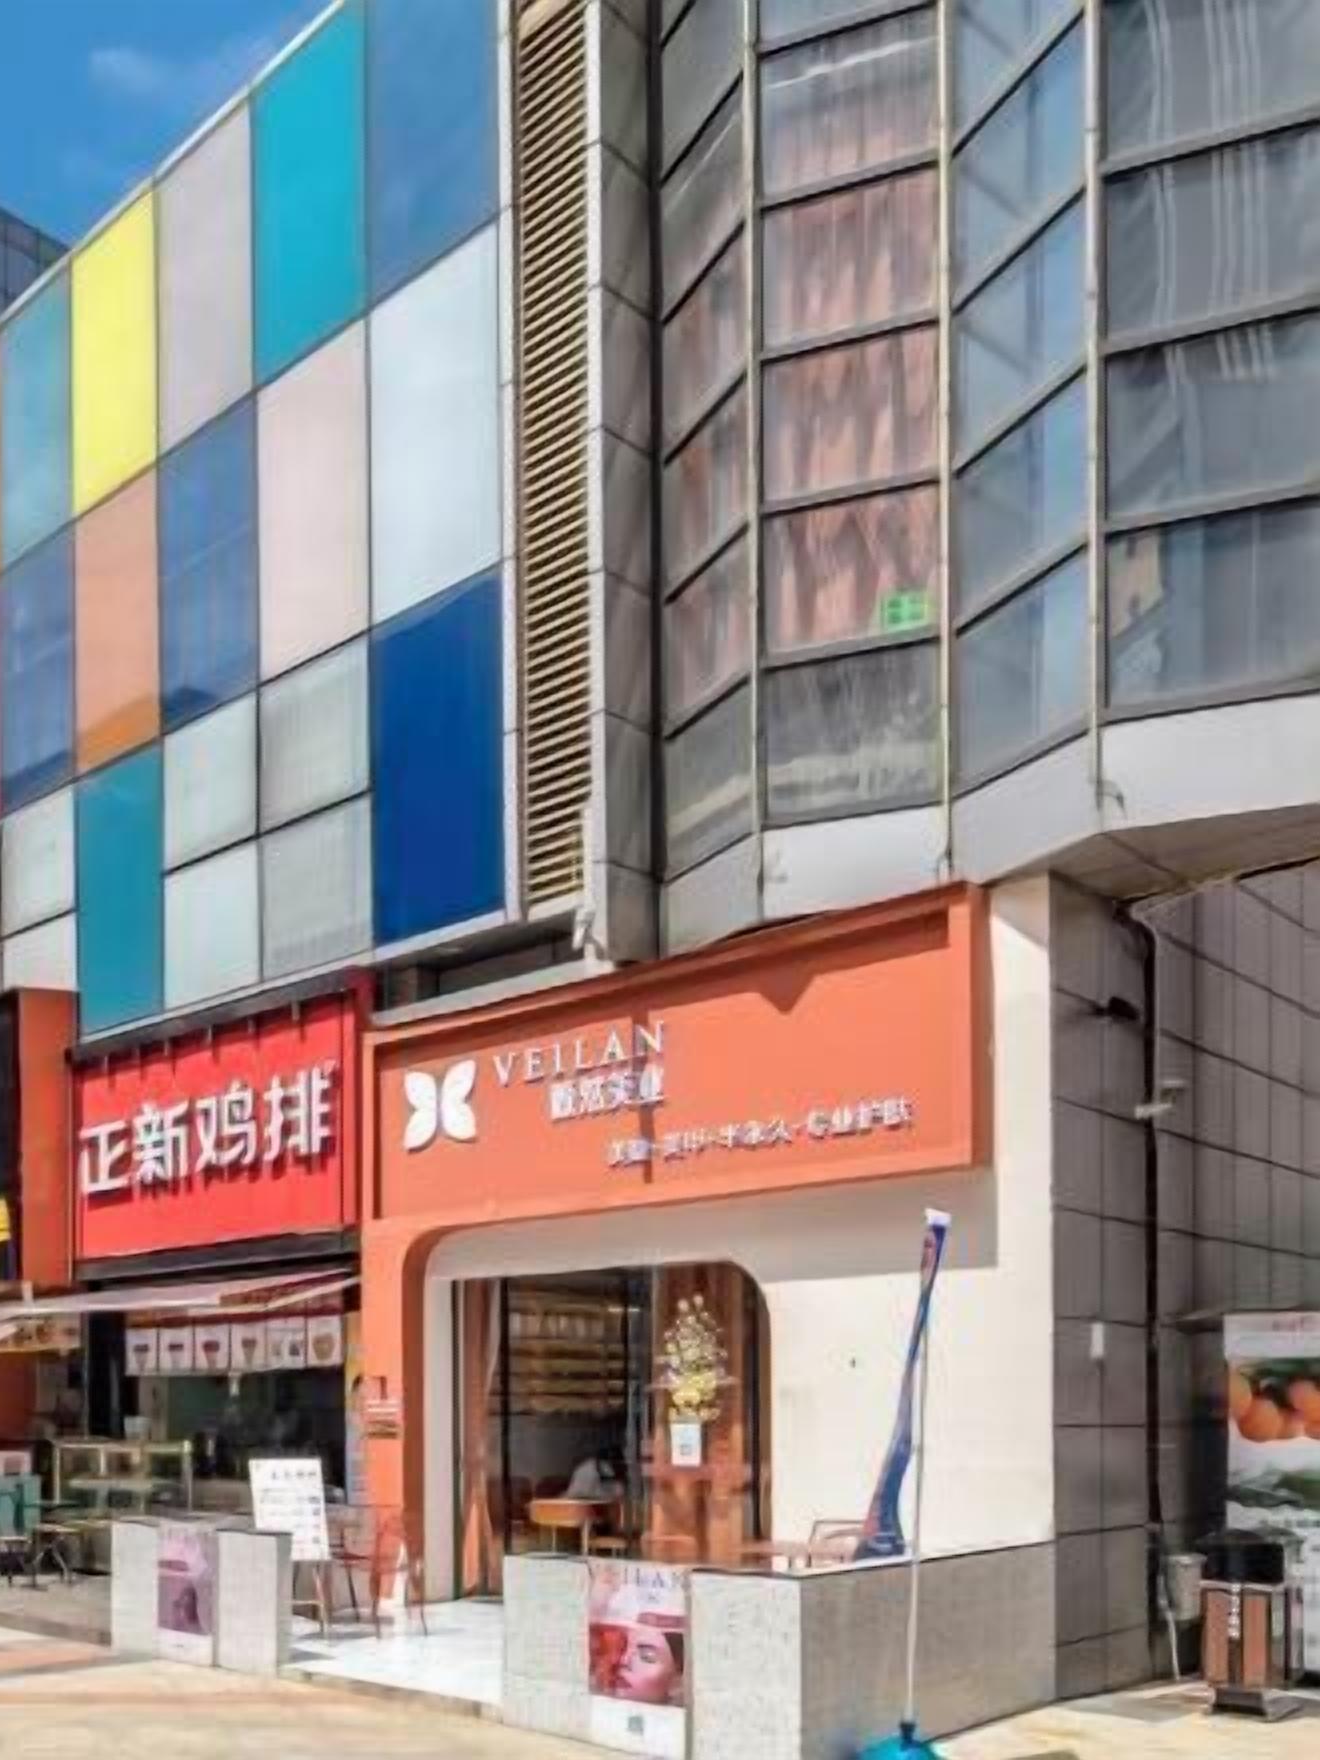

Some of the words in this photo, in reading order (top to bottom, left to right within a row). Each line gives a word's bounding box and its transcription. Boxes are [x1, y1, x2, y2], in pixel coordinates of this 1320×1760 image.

[492, 1020, 666, 1087] VEILAN
[79, 1060, 339, 1193] 正新鸡排
